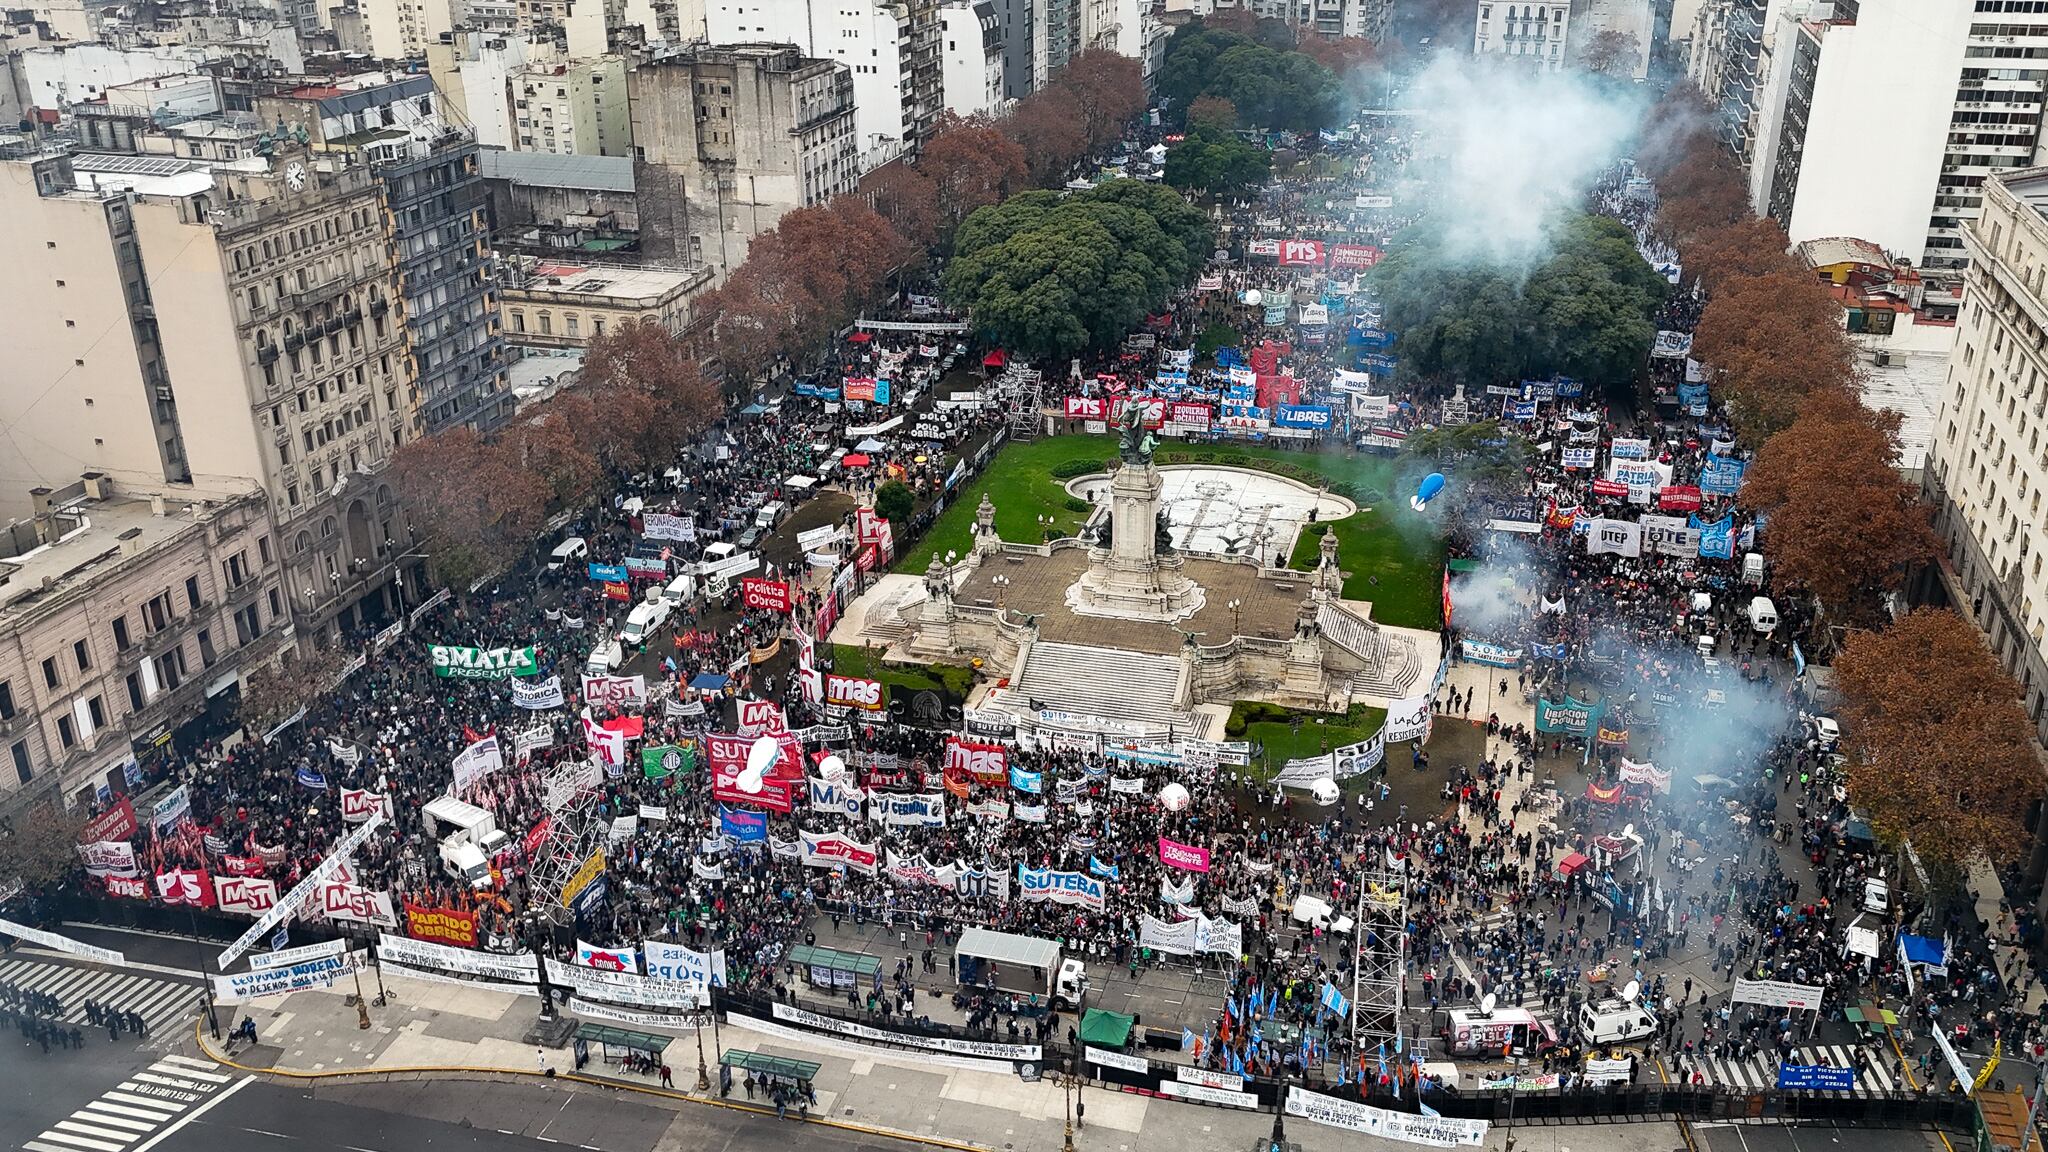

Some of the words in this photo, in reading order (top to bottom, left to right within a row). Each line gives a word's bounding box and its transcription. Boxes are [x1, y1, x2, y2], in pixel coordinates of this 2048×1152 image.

[1285, 242, 1315, 259] PTS
[1335, 247, 1373, 257] IZQUIERDA
[1362, 330, 1387, 340] LIBRES
[1663, 335, 1682, 346] UTEP
[1345, 380, 1368, 390] IBRES
[1069, 400, 1100, 415] PTS
[1175, 406, 1209, 416] IZQUIERDA
[1174, 413, 1209, 423] SOCIALISTA
[1285, 408, 1327, 424] LIBRES
[911, 429, 946, 440] OBRERO
[916, 423, 939, 433] POLO
[1564, 449, 1592, 457] CCC
[1617, 471, 1654, 480] PATRIA
[1601, 530, 1628, 545] UTEP
[748, 595, 784, 609] Obrera
[432, 647, 531, 669] SMATA
[449, 667, 516, 679] PRESENTE
[589, 678, 636, 705] MST
[830, 677, 880, 705] mas
[977, 722, 1004, 731] SUTEP
[712, 740, 790, 763] SUTA
[953, 742, 1003, 775] mas
[225, 859, 246, 871] PTS
[955, 872, 1000, 897] UTE
[1023, 873, 1101, 899] SUTEBA
[225, 884, 271, 911] MST
[329, 885, 382, 917] MST
[409, 912, 473, 931] PARTIDO
[414, 924, 472, 943] OBRERO
[236, 987, 247, 996] NO
[250, 980, 290, 995] DEJEMOS
